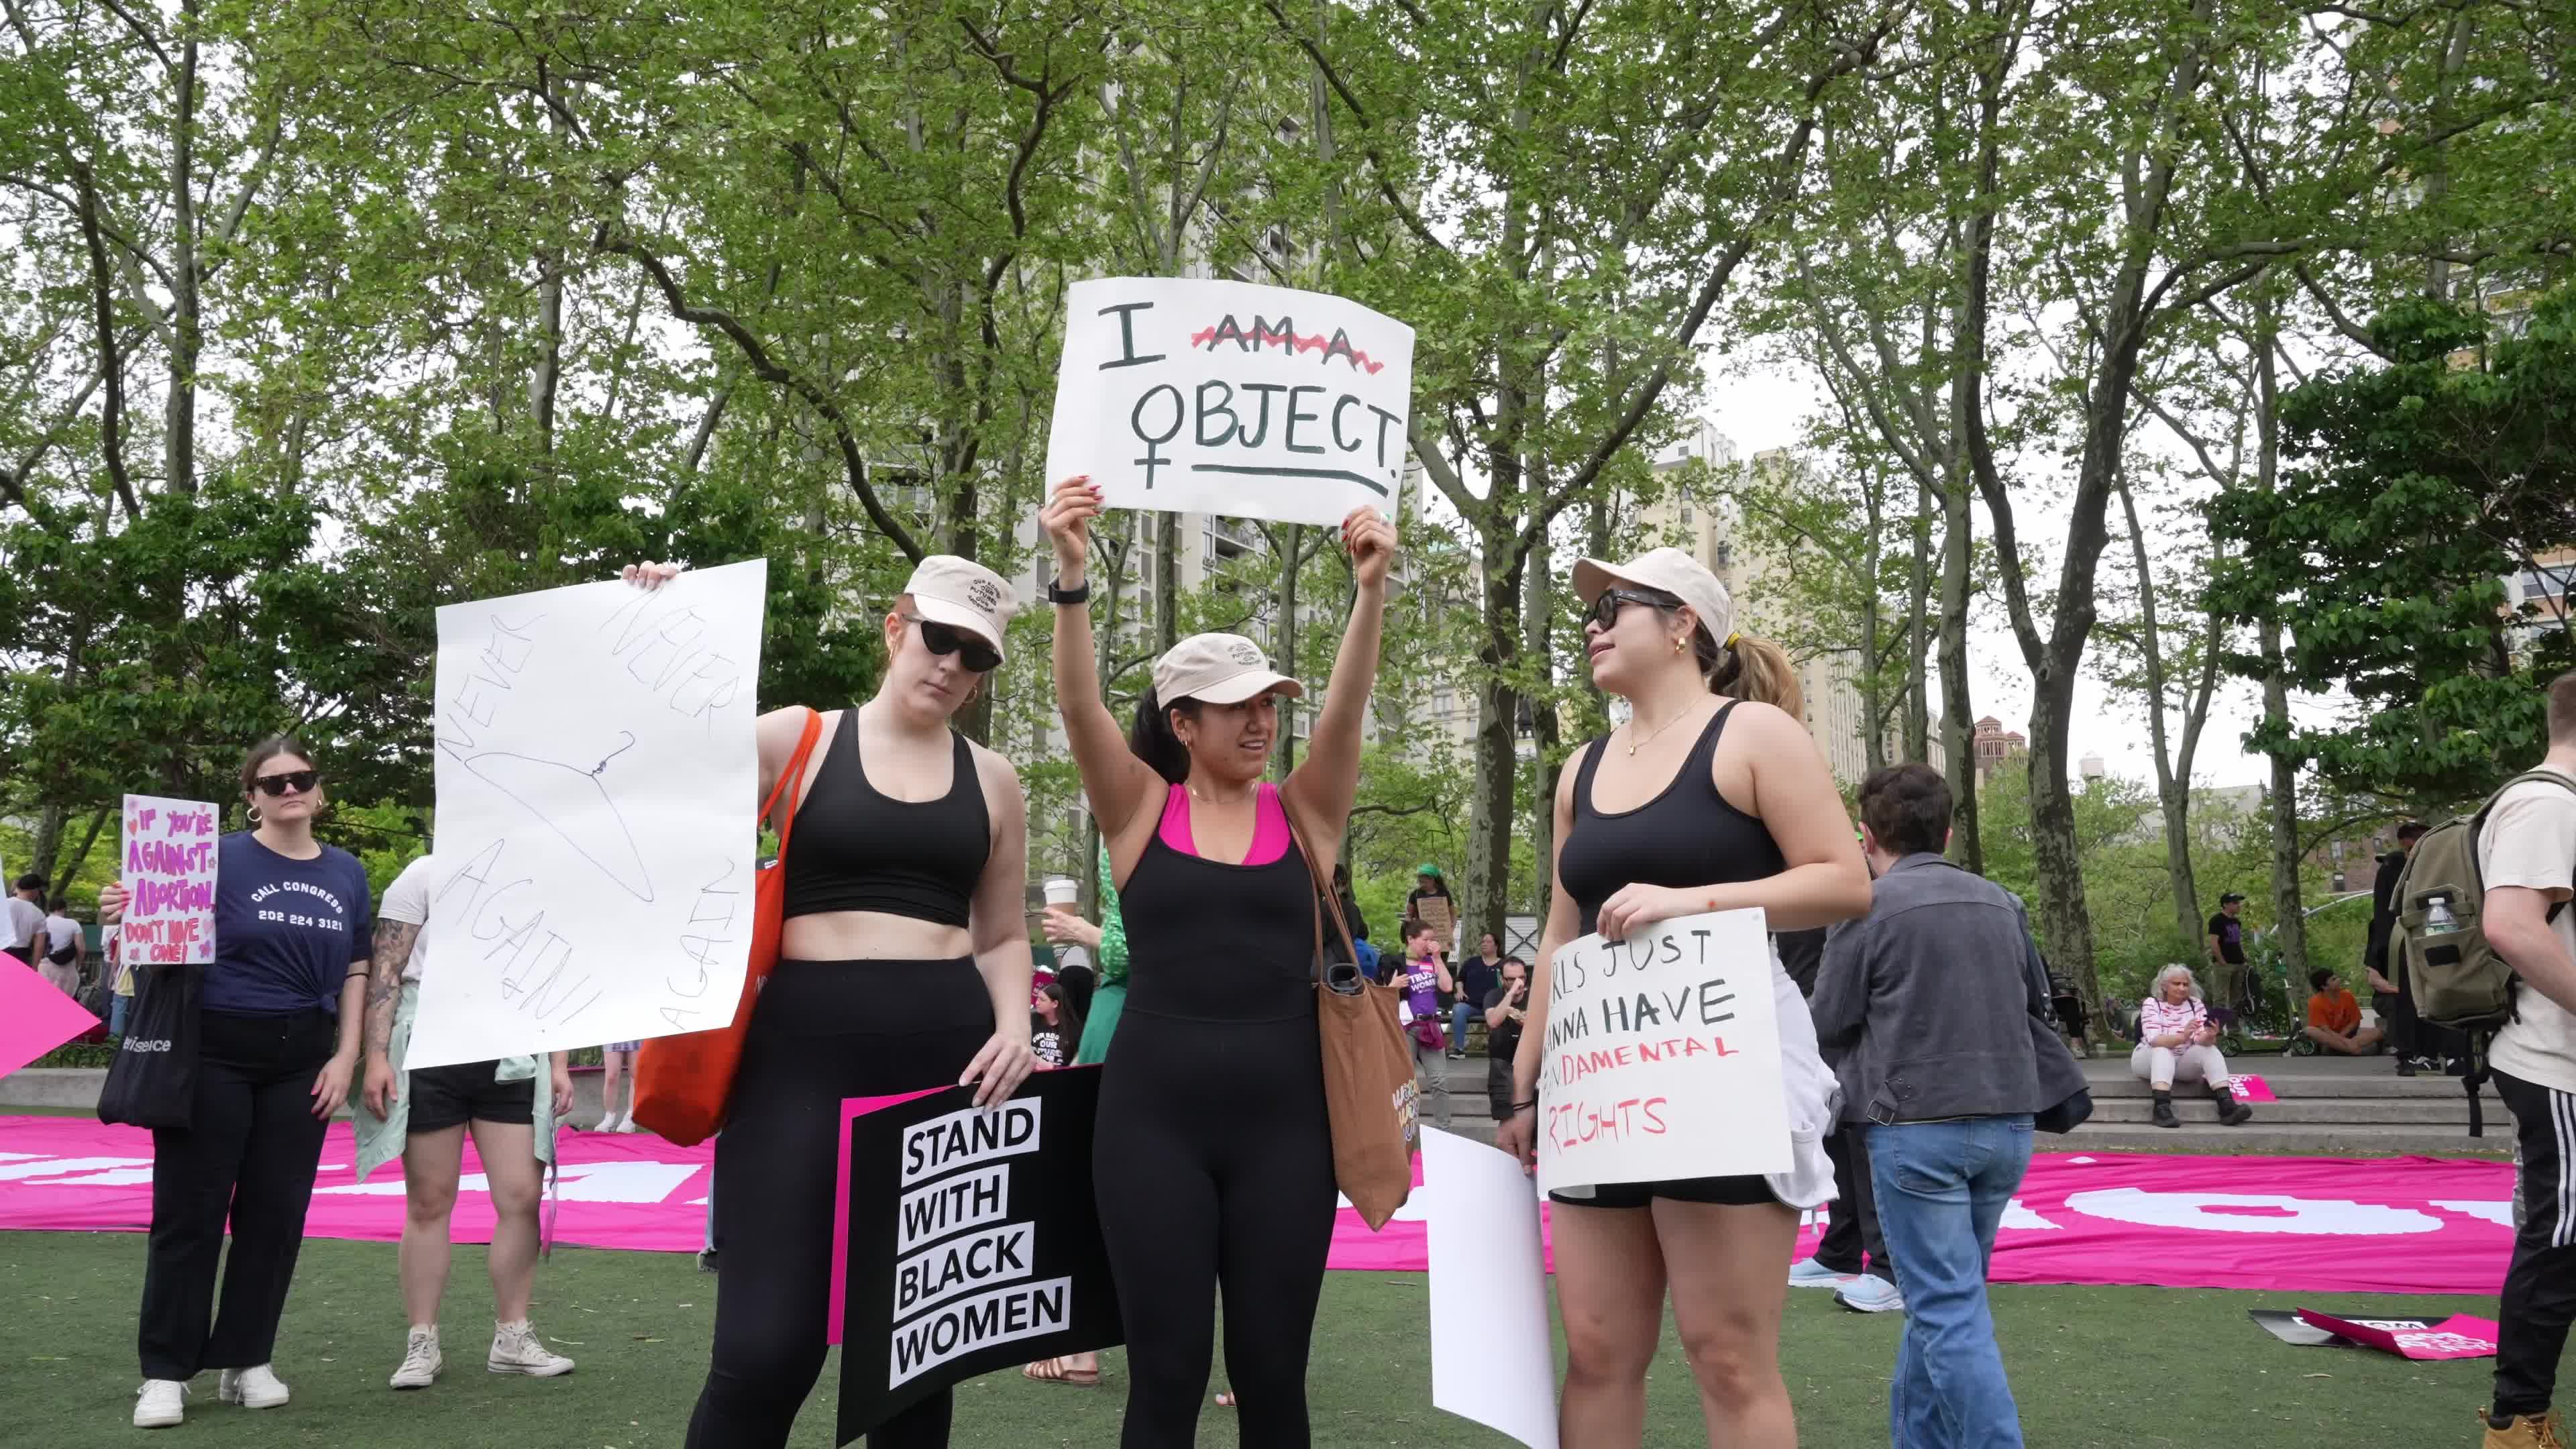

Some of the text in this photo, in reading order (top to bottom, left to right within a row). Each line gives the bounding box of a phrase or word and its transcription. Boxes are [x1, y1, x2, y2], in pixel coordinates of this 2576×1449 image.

[1098, 302, 1357, 372] I AM A
[139, 808, 213, 837] IF YOU'RE
[128, 840, 212, 876] AGAINST
[251, 881, 343, 914] CALL CONGRESS
[258, 910, 343, 932] 202 224 3121
[150, 943, 189, 965] ONE!
[168, 917, 200, 944] HAVE
[1552, 929, 1711, 1005] RLS JUST
[1602, 978, 1735, 1034] HAVE
[1545, 1036, 1739, 1095] NDAMENTAL
[906, 1107, 1034, 1176] STAND
[1548, 1097, 1667, 1156] RIGHTS
[904, 1174, 1000, 1242] WITH
[898, 1230, 1025, 1311] BLACK
[896, 1285, 1063, 1375] WOMEN
